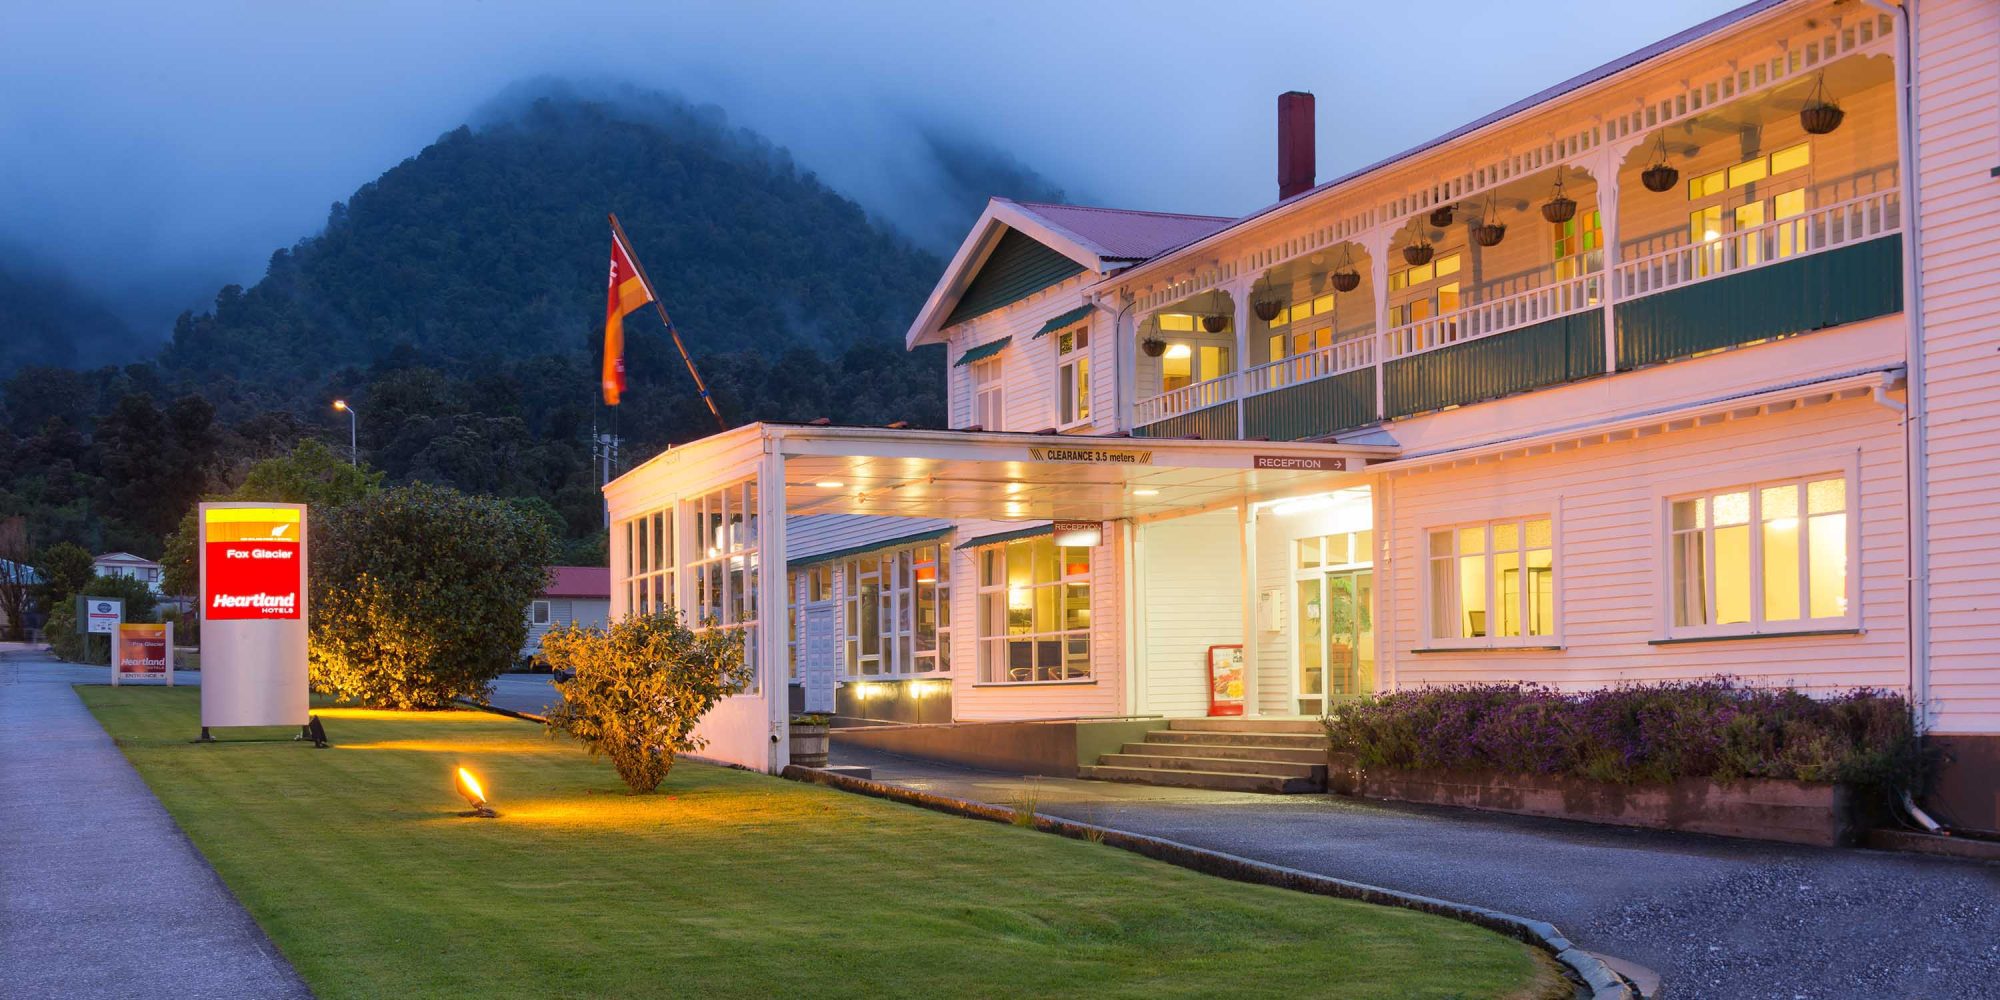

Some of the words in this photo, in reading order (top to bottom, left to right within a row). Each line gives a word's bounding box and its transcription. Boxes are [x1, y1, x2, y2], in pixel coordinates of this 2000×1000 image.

[1047, 450, 1093, 461] CLEARANCE
[1095, 452, 1107, 461] 3.5
[1109, 453, 1135, 462] meters
[1259, 458, 1321, 468] RECEPTION
[1055, 523, 1101, 531] RECEPTION
[226, 549, 249, 558] Fox
[252, 549, 293, 558] Glacier
[213, 592, 295, 607] Heartland
[121, 658, 165, 666] Heartland
